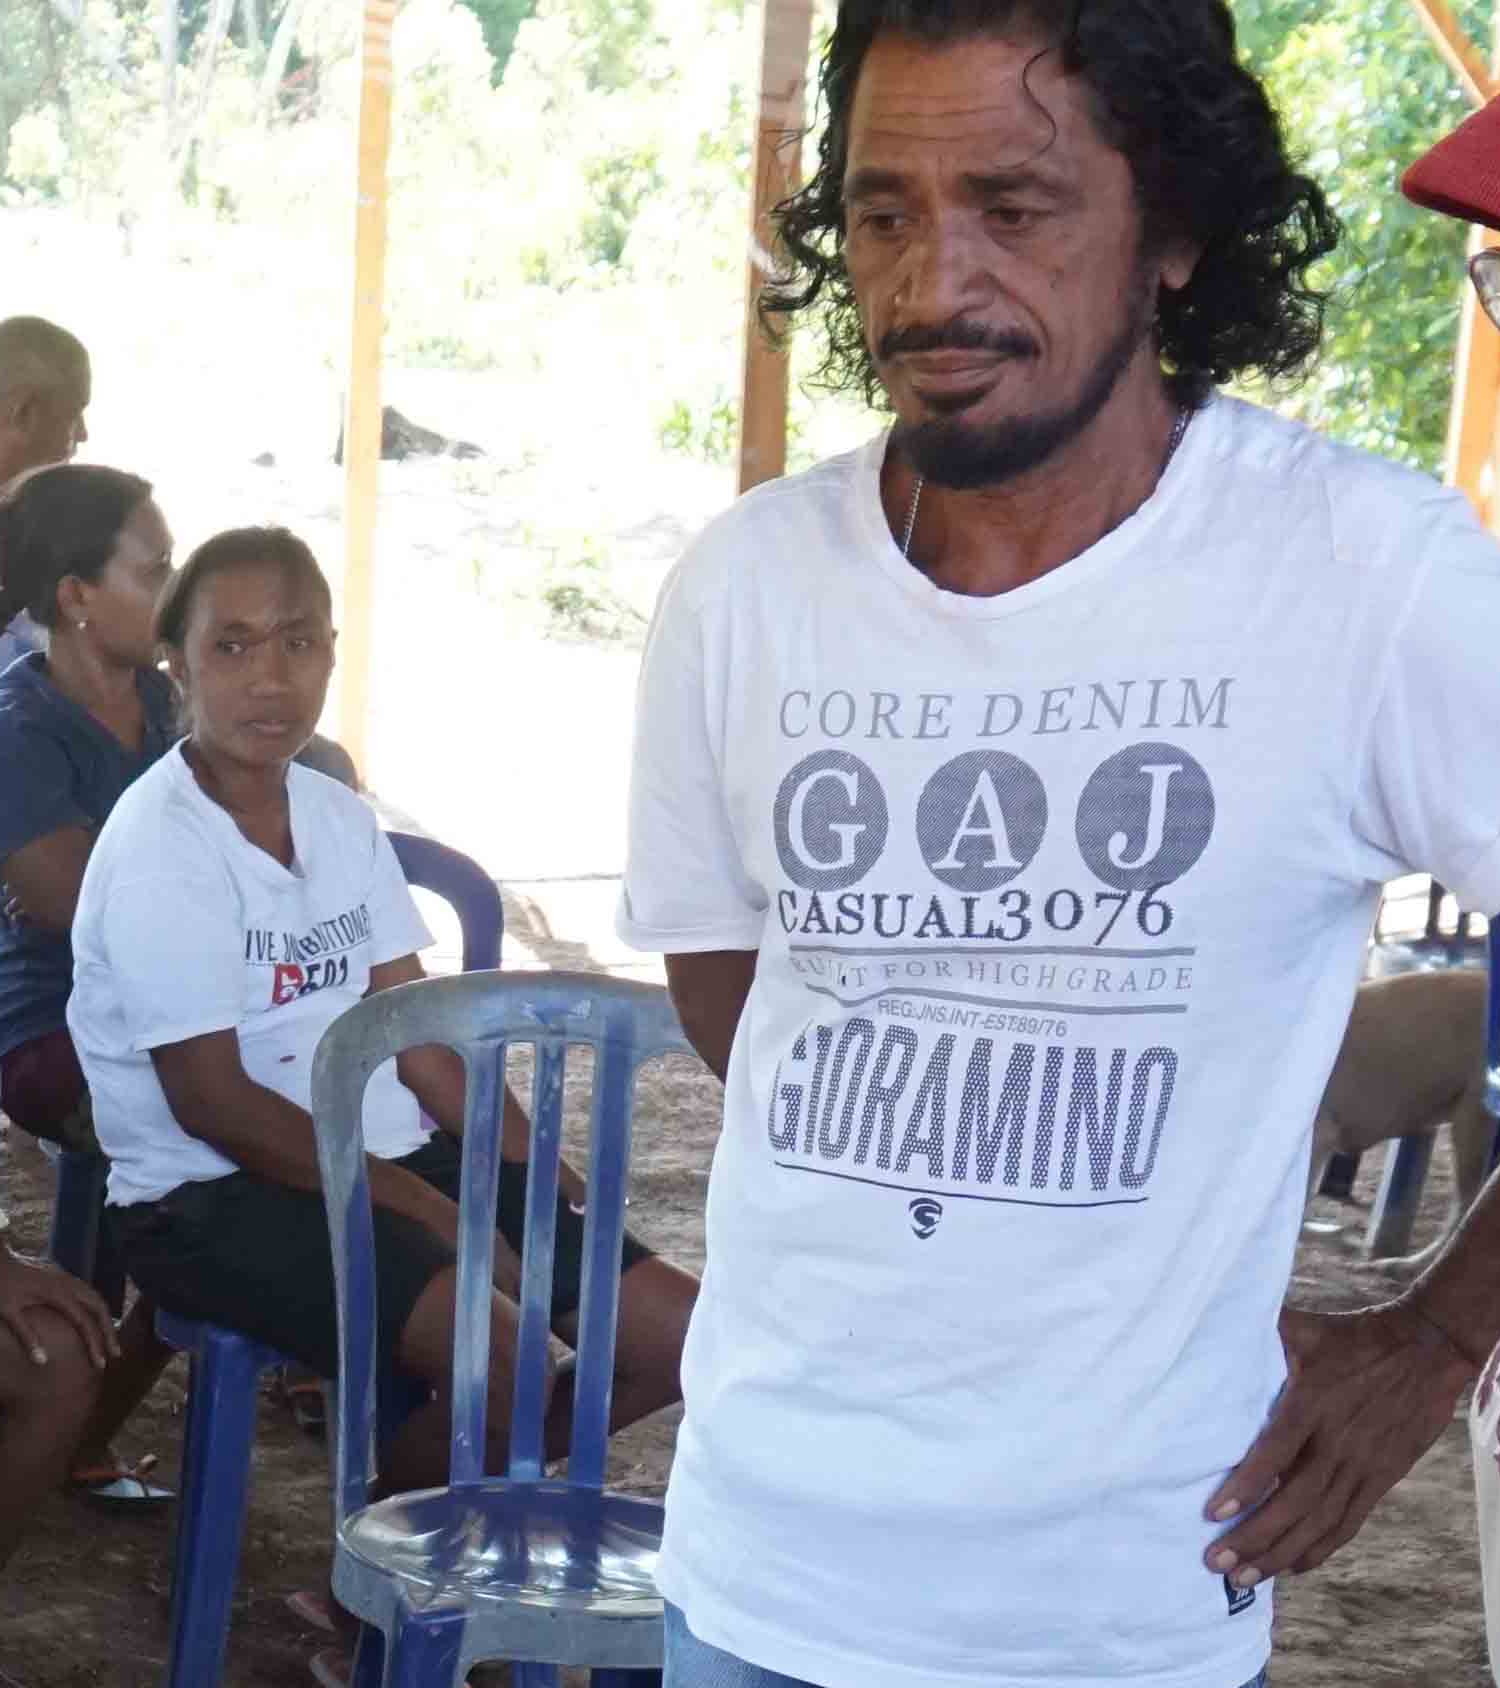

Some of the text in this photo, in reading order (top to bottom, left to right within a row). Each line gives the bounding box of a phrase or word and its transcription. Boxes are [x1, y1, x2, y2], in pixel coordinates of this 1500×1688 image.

[780, 677, 1238, 740] CORE DENIM
[884, 961, 953, 979] FOR
[769, 1017, 1179, 1192] GIORAMINO
